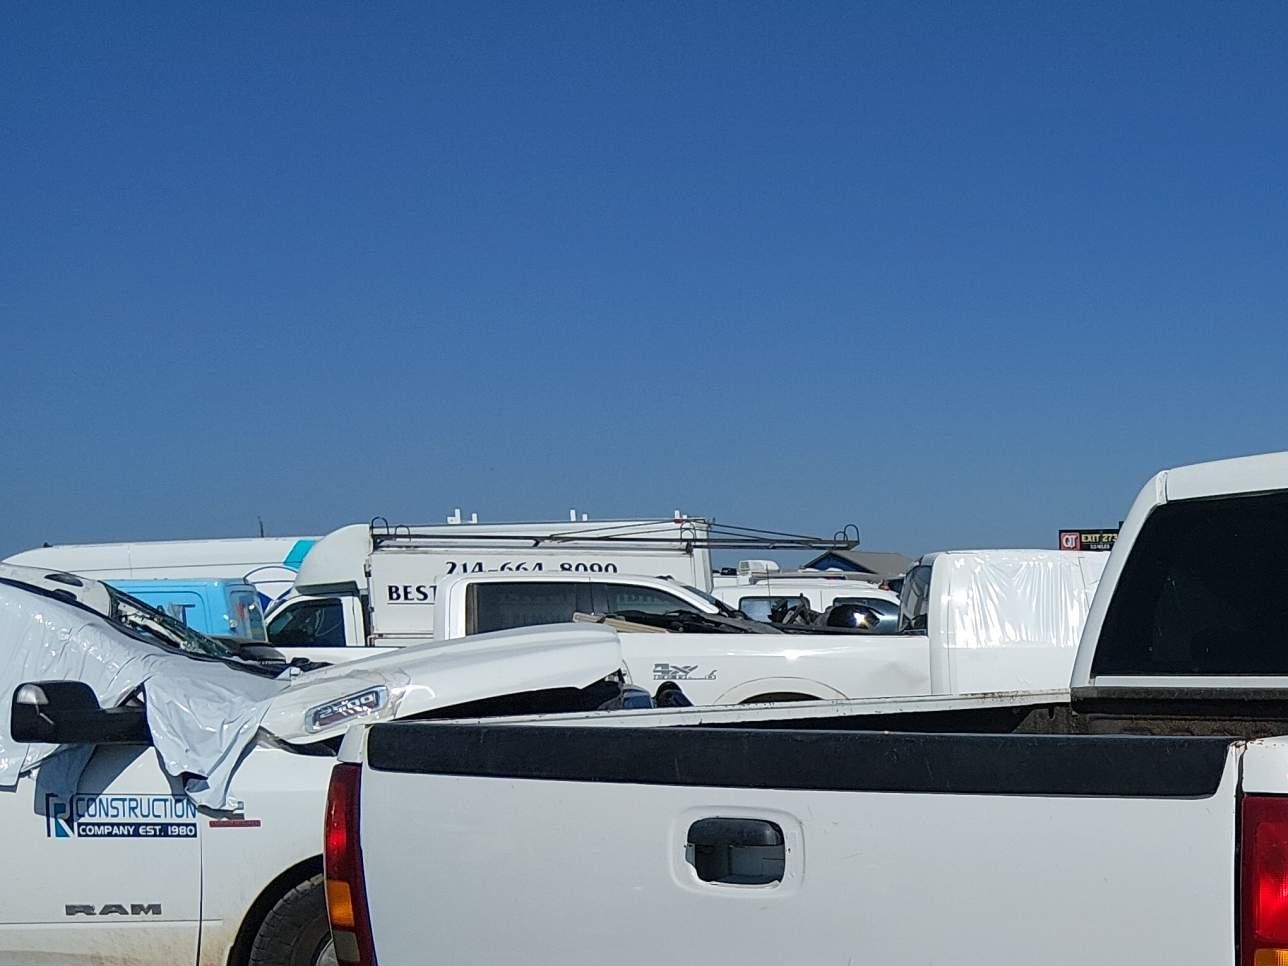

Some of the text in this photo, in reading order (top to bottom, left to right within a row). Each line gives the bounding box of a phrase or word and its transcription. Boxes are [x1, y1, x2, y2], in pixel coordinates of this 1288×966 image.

[1081, 534, 1101, 542] EXIT
[75, 797, 197, 819] CONSTRUCTION
[78, 825, 195, 836] COMPANY EST. 1980
[65, 904, 162, 916] RAM
